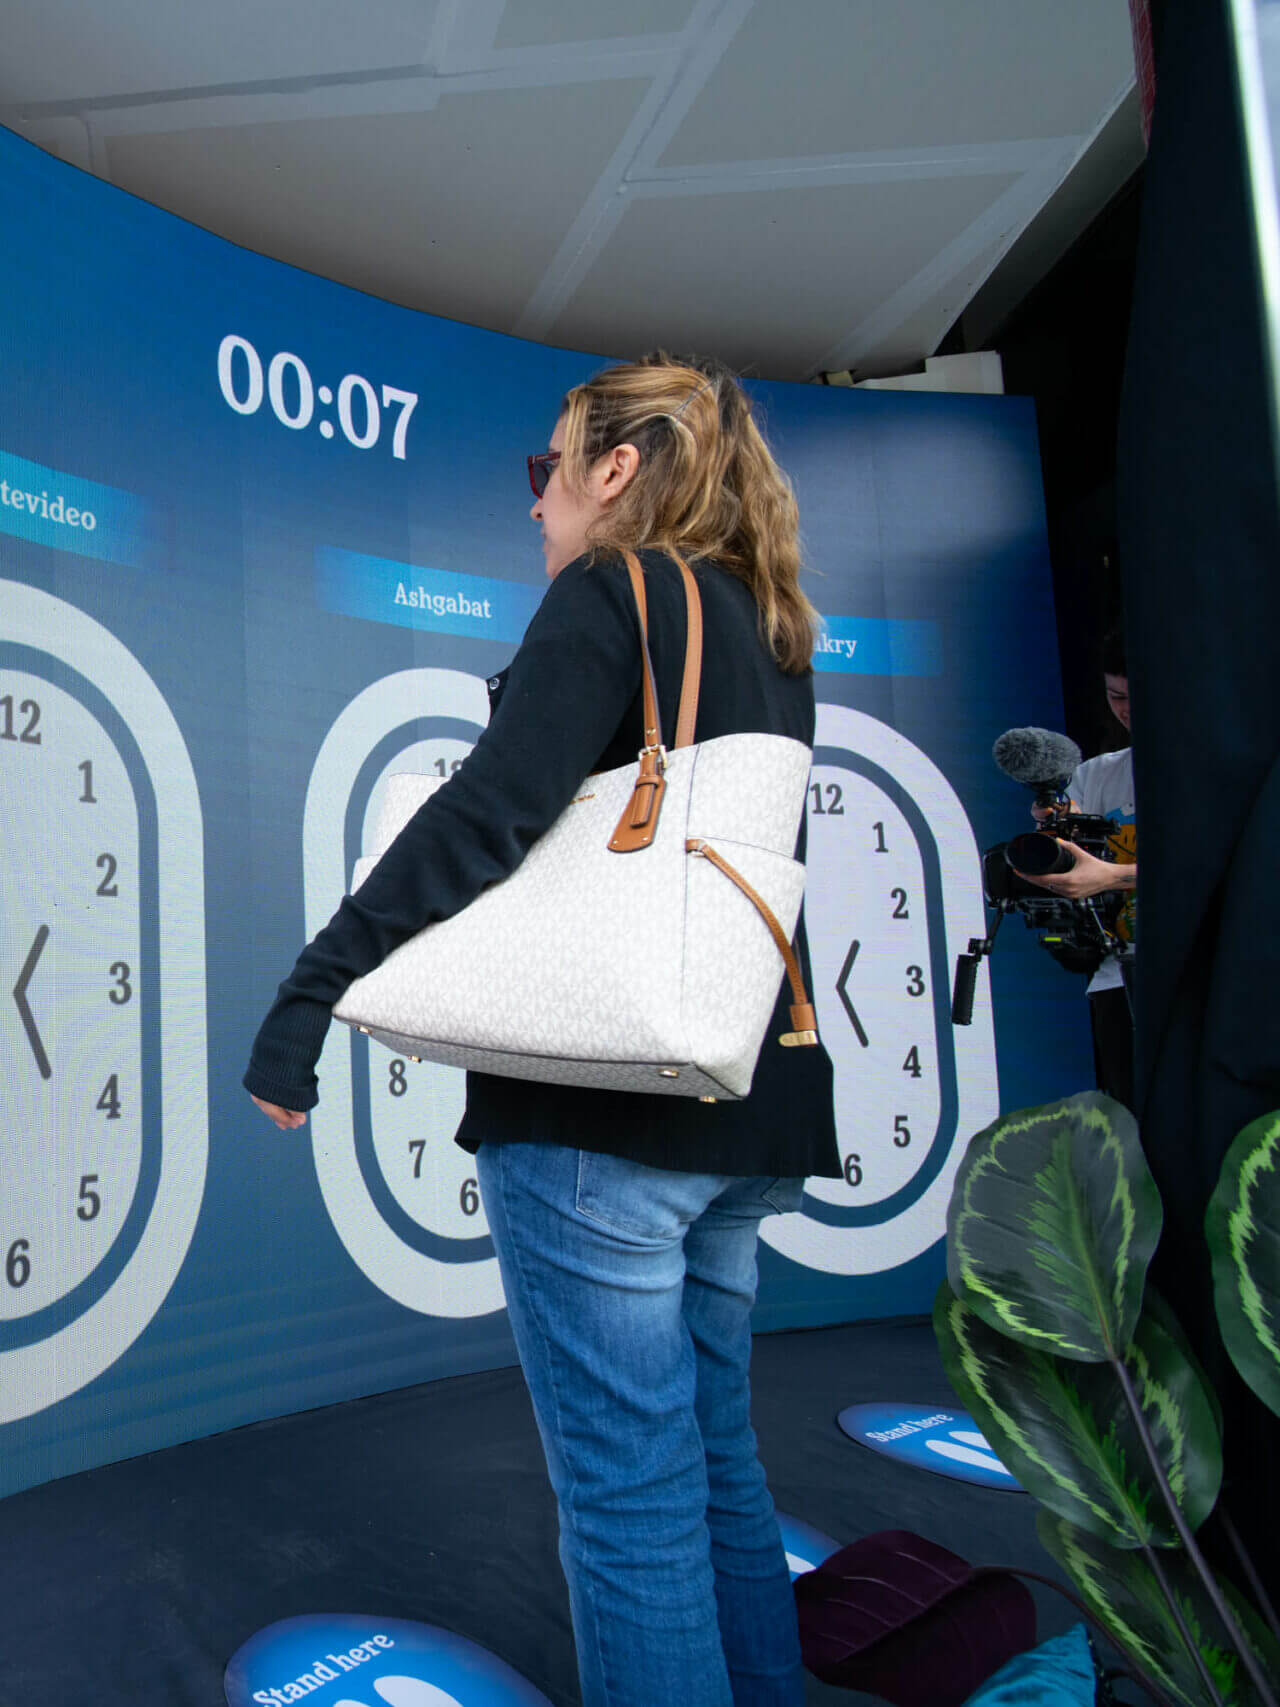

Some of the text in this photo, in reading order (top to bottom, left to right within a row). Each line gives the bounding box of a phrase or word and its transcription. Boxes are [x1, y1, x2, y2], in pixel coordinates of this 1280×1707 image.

[218, 335, 417, 459] 00:07
[394, 582, 492, 618] Ashgabat
[816, 632, 857, 658] kry
[0, 695, 42, 745] 12
[78, 759, 97, 804] 1
[809, 782, 846, 817] 12
[873, 821, 888, 854] 1
[96, 852, 119, 898] 2
[890, 887, 910, 920] 2
[108, 960, 133, 1006] 3
[905, 964, 926, 998] 3
[388, 1058, 408, 1098] 8
[902, 1045, 921, 1079] 4
[96, 1074, 121, 1120] 4
[893, 1114, 912, 1149] 5
[408, 1139, 427, 1179] 7
[843, 1153, 863, 1187] 6
[76, 1174, 101, 1222] 5
[459, 1177, 480, 1218] 6
[5, 1238, 31, 1289] 6
[865, 1414, 953, 1441] Stand here
[253, 1634, 395, 1707] Stand here
